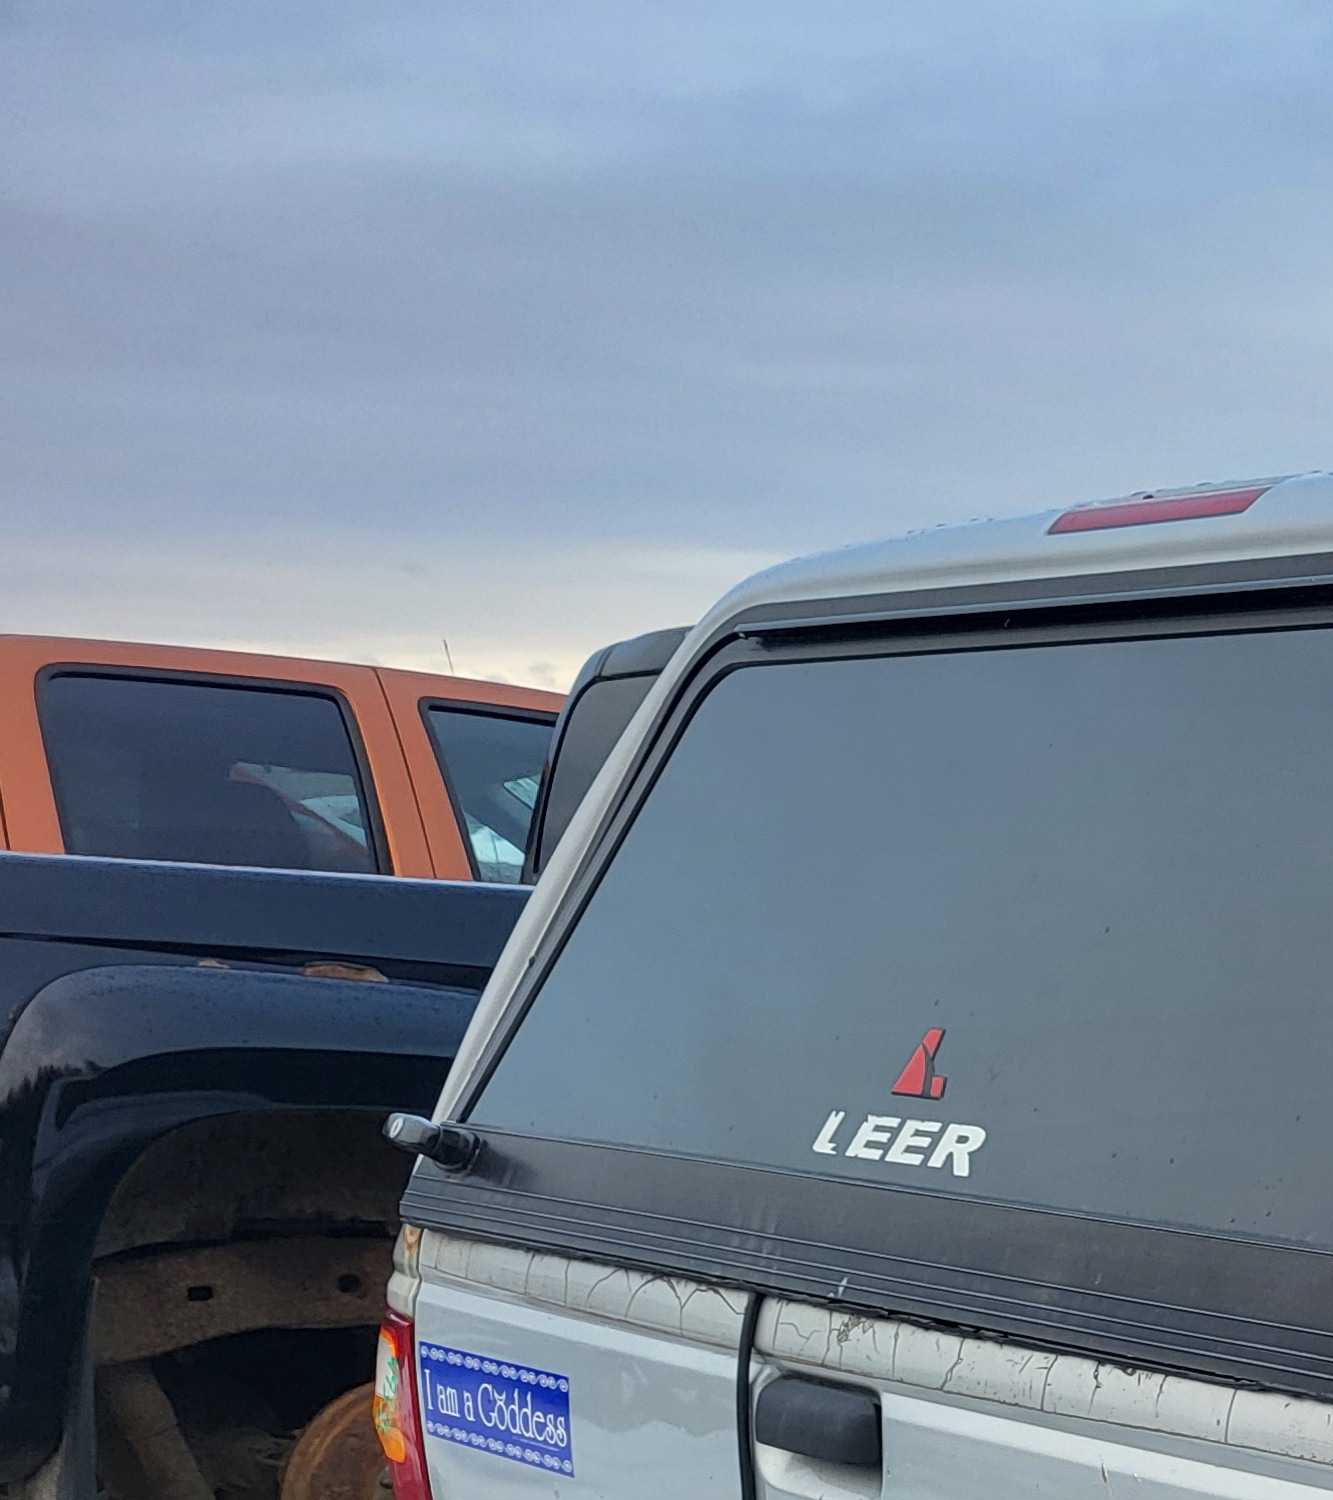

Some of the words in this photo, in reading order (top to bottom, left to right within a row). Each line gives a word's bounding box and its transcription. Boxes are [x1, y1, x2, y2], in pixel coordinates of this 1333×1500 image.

[812, 1110, 986, 1177] LEER
[424, 1368, 434, 1410] I
[436, 1384, 460, 1417] am
[463, 1390, 476, 1422] a
[477, 1383, 568, 1448] Goddess
